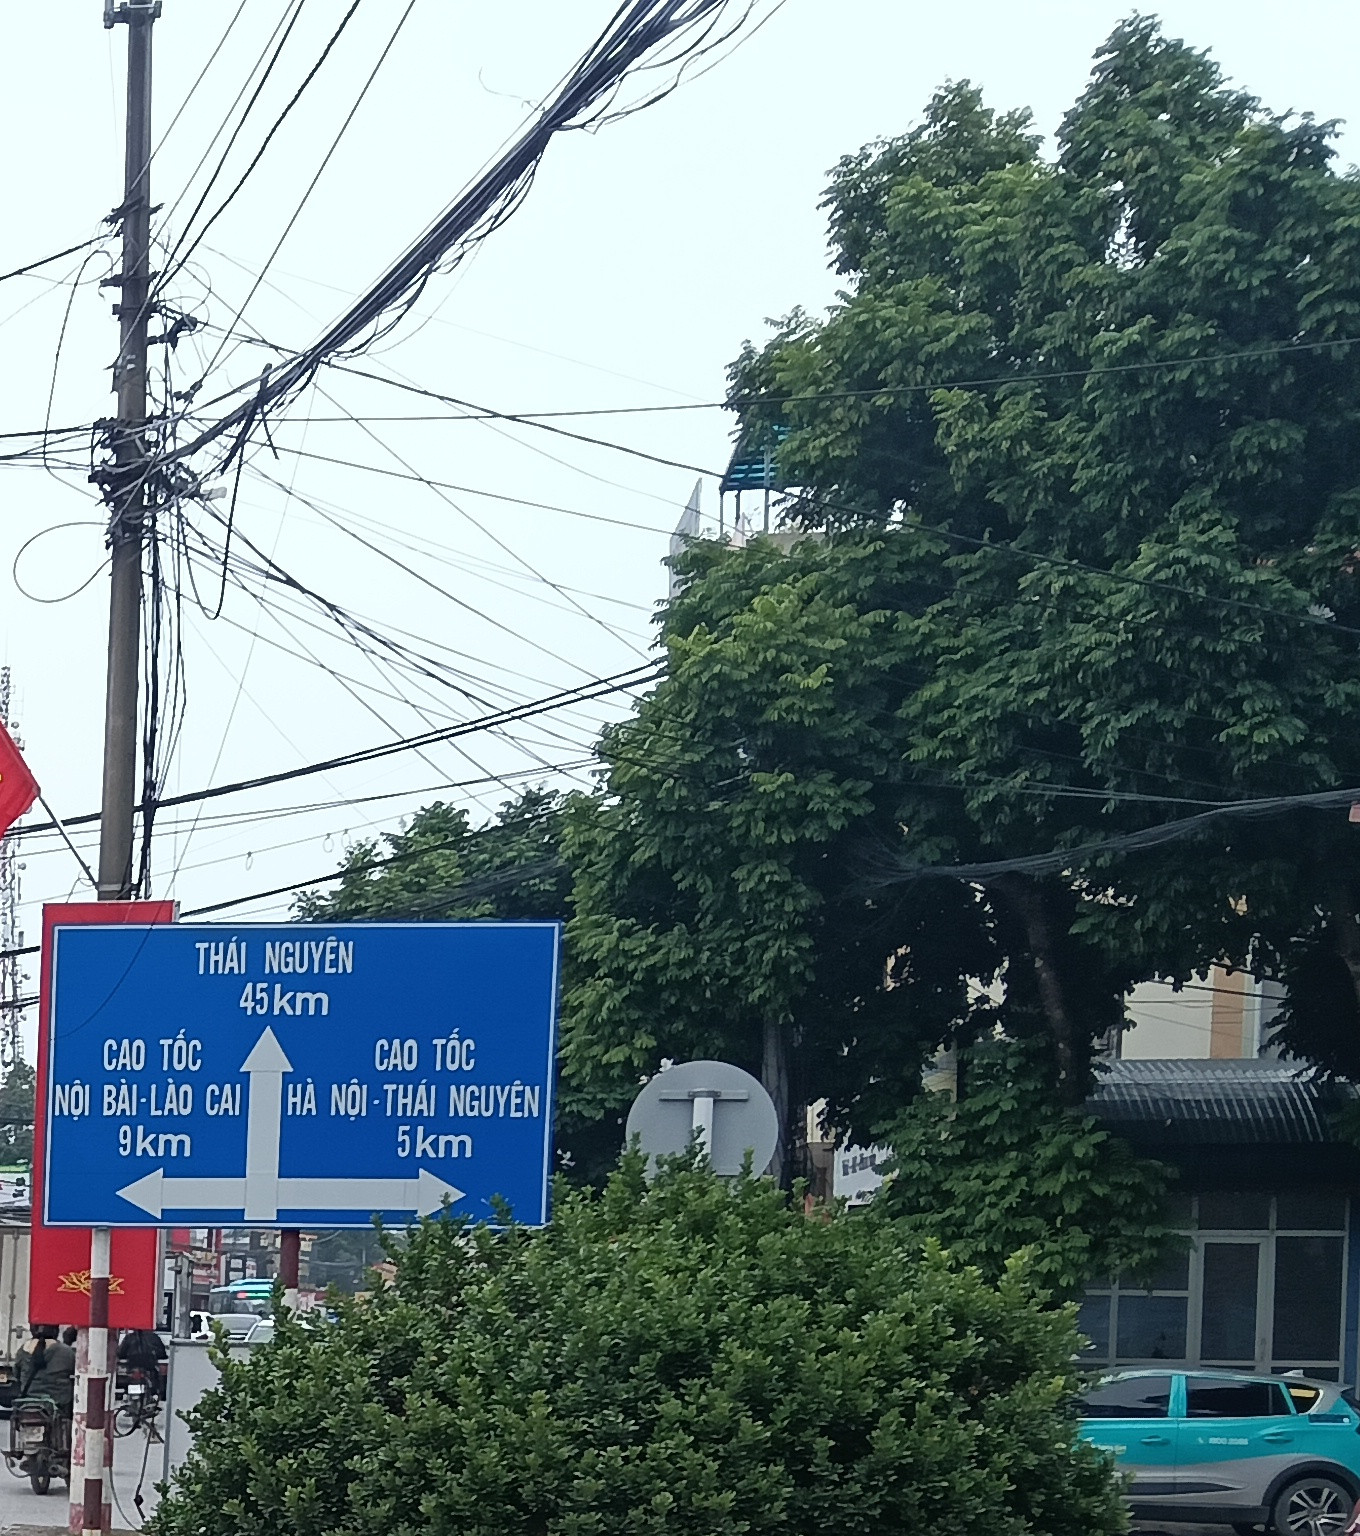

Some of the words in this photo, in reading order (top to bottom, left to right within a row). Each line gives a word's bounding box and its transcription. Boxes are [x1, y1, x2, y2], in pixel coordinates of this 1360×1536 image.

[195, 935, 247, 975] THÁI
[264, 935, 354, 975] NGUYÊN
[102, 1038, 146, 1071] CAO
[159, 1028, 202, 1071] TỐC
[374, 1038, 418, 1071] CAO
[432, 1027, 476, 1071] TỐC
[54, 1079, 90, 1121] NỘI
[205, 1083, 241, 1116] CAI
[287, 1077, 317, 1116] HÀ
[449, 1079, 540, 1118] NGUYÊN
